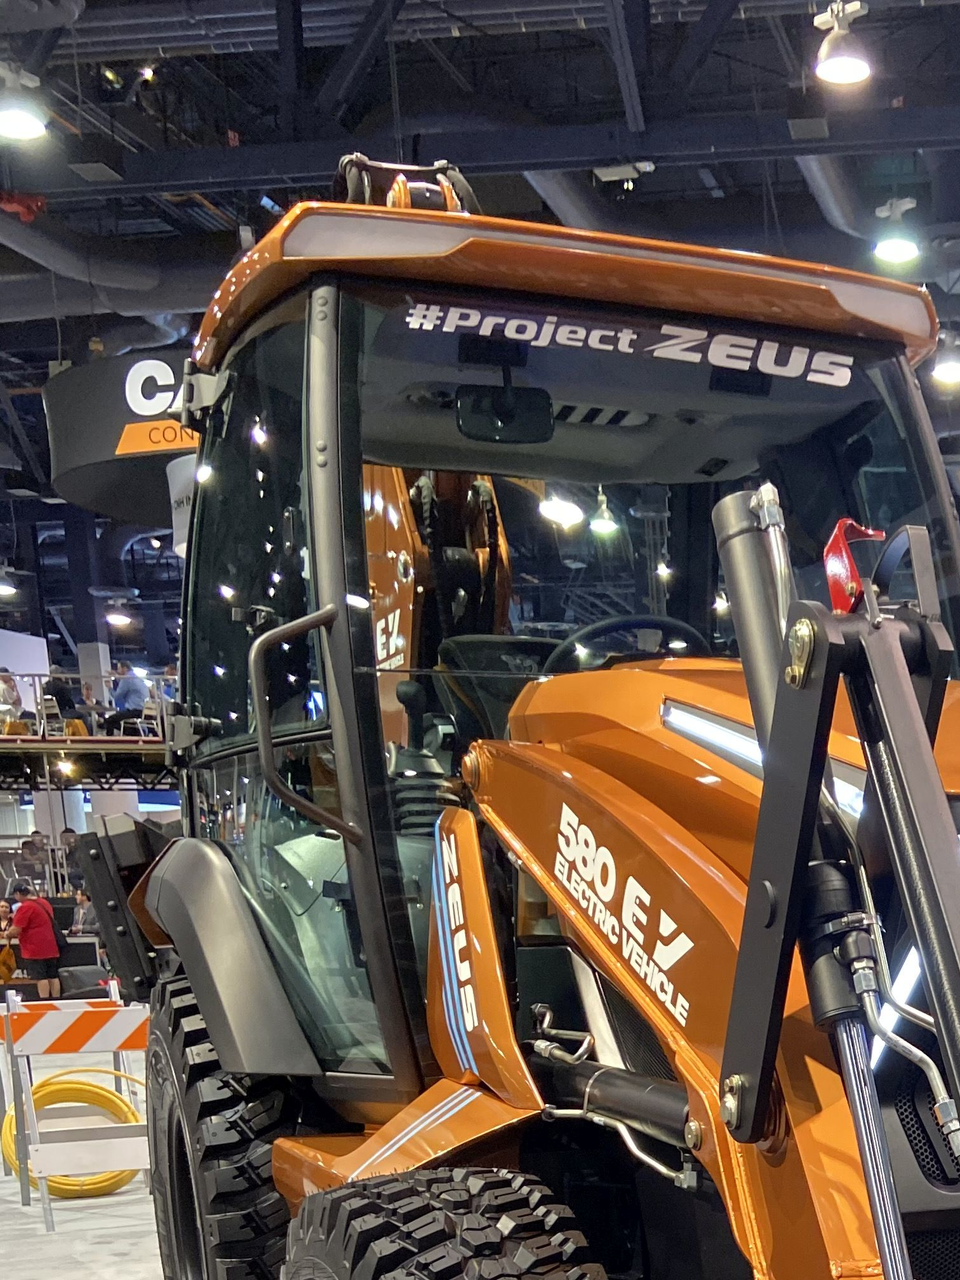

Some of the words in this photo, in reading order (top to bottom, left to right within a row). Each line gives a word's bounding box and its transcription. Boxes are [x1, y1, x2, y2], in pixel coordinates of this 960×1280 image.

[405, 302, 639, 355] #Project
[643, 323, 855, 388] ZEUS
[441, 832, 479, 1033] ZEUS
[553, 851, 620, 945] ELECTRIC
[621, 927, 690, 1028] VEHICLE
[557, 801, 617, 903] 580
[621, 875, 695, 971] EV
